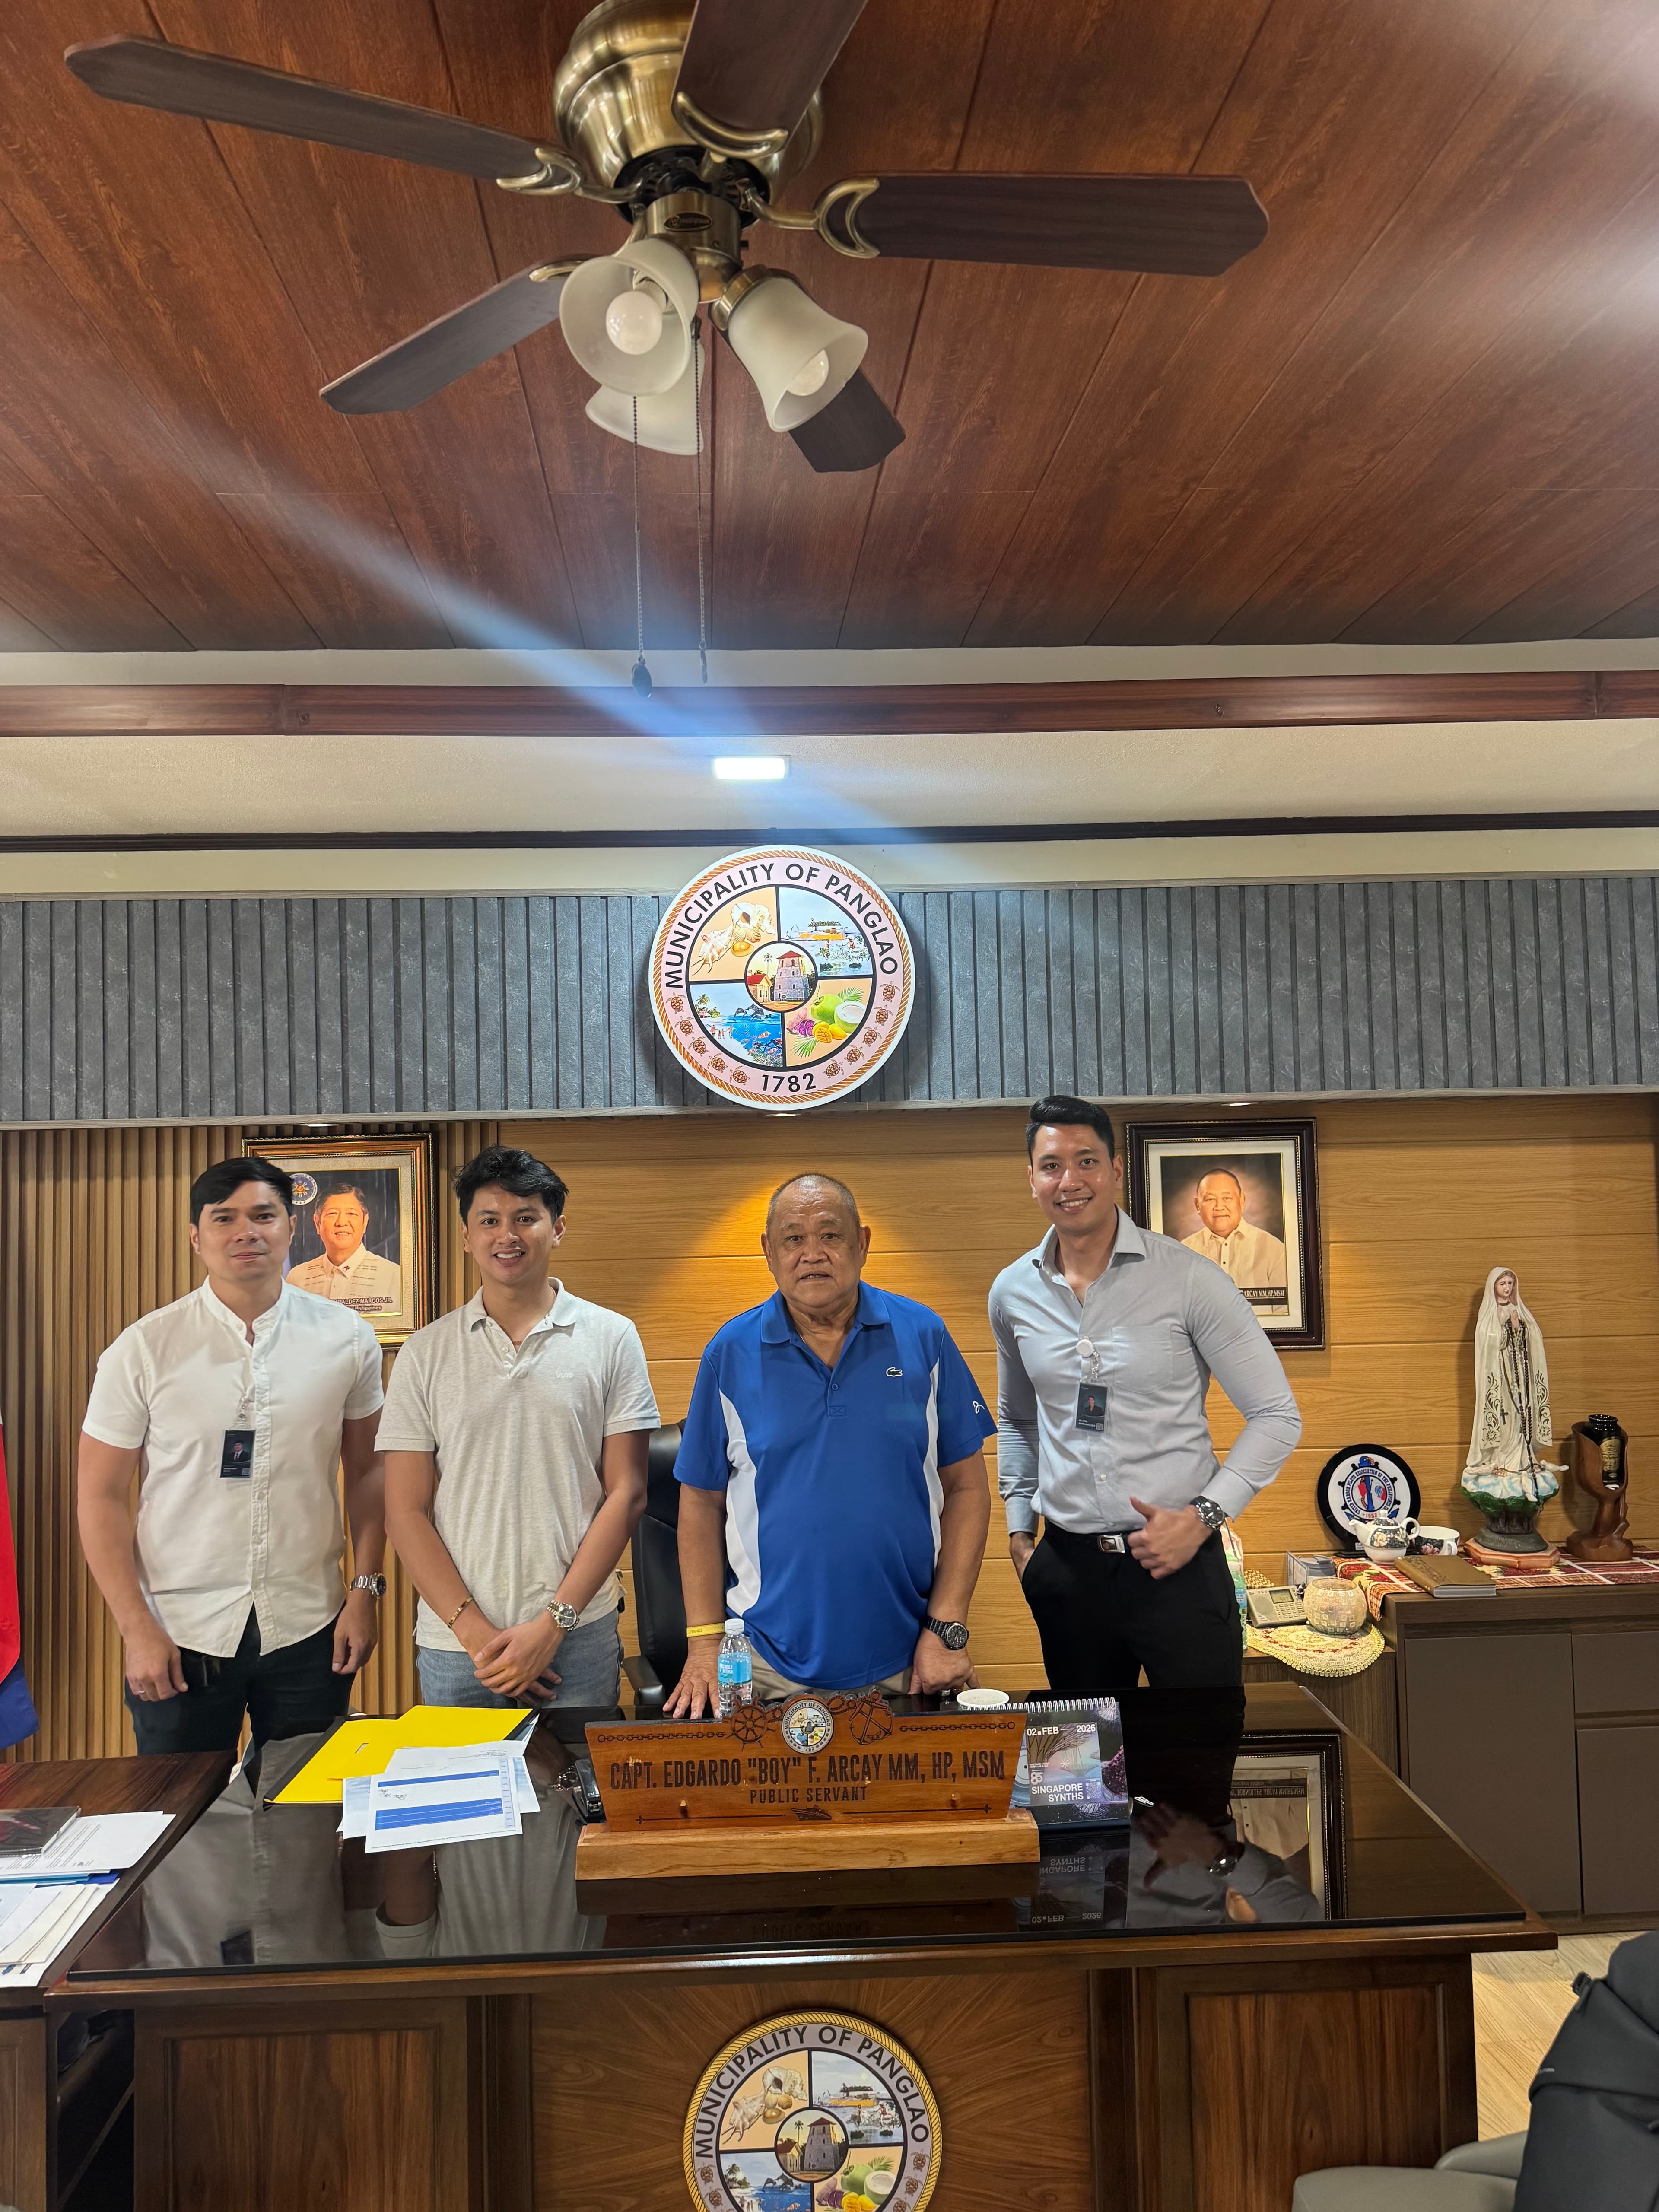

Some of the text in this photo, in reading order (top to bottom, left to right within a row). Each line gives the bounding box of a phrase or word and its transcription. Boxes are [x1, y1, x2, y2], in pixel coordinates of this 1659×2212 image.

[665, 863, 898, 989] MUNICIPALITY OF PANGLAO
[762, 1073, 816, 1093] 1782
[1347, 1474, 1357, 1486] PILOTS
[1355, 1468, 1378, 1477] ASSOCIATION
[1349, 1503, 1360, 1515] UNITED
[785, 1703, 807, 1729] MUNICIPALITY
[816, 1704, 831, 1727] PANGLAO
[1076, 1724, 1096, 1733] 2026
[610, 1750, 1004, 1790] CAPT. EDGARDO "BOY" F. ARCAY MM, HP, MSM
[750, 1786, 867, 1804] PUBLIC SERVANT
[1031, 1783, 1083, 1794] SINGAPORE
[1048, 1792, 1084, 1802] SYNTHS
[695, 2026, 929, 2158] MUNICIPALITY OF PANGLAO
